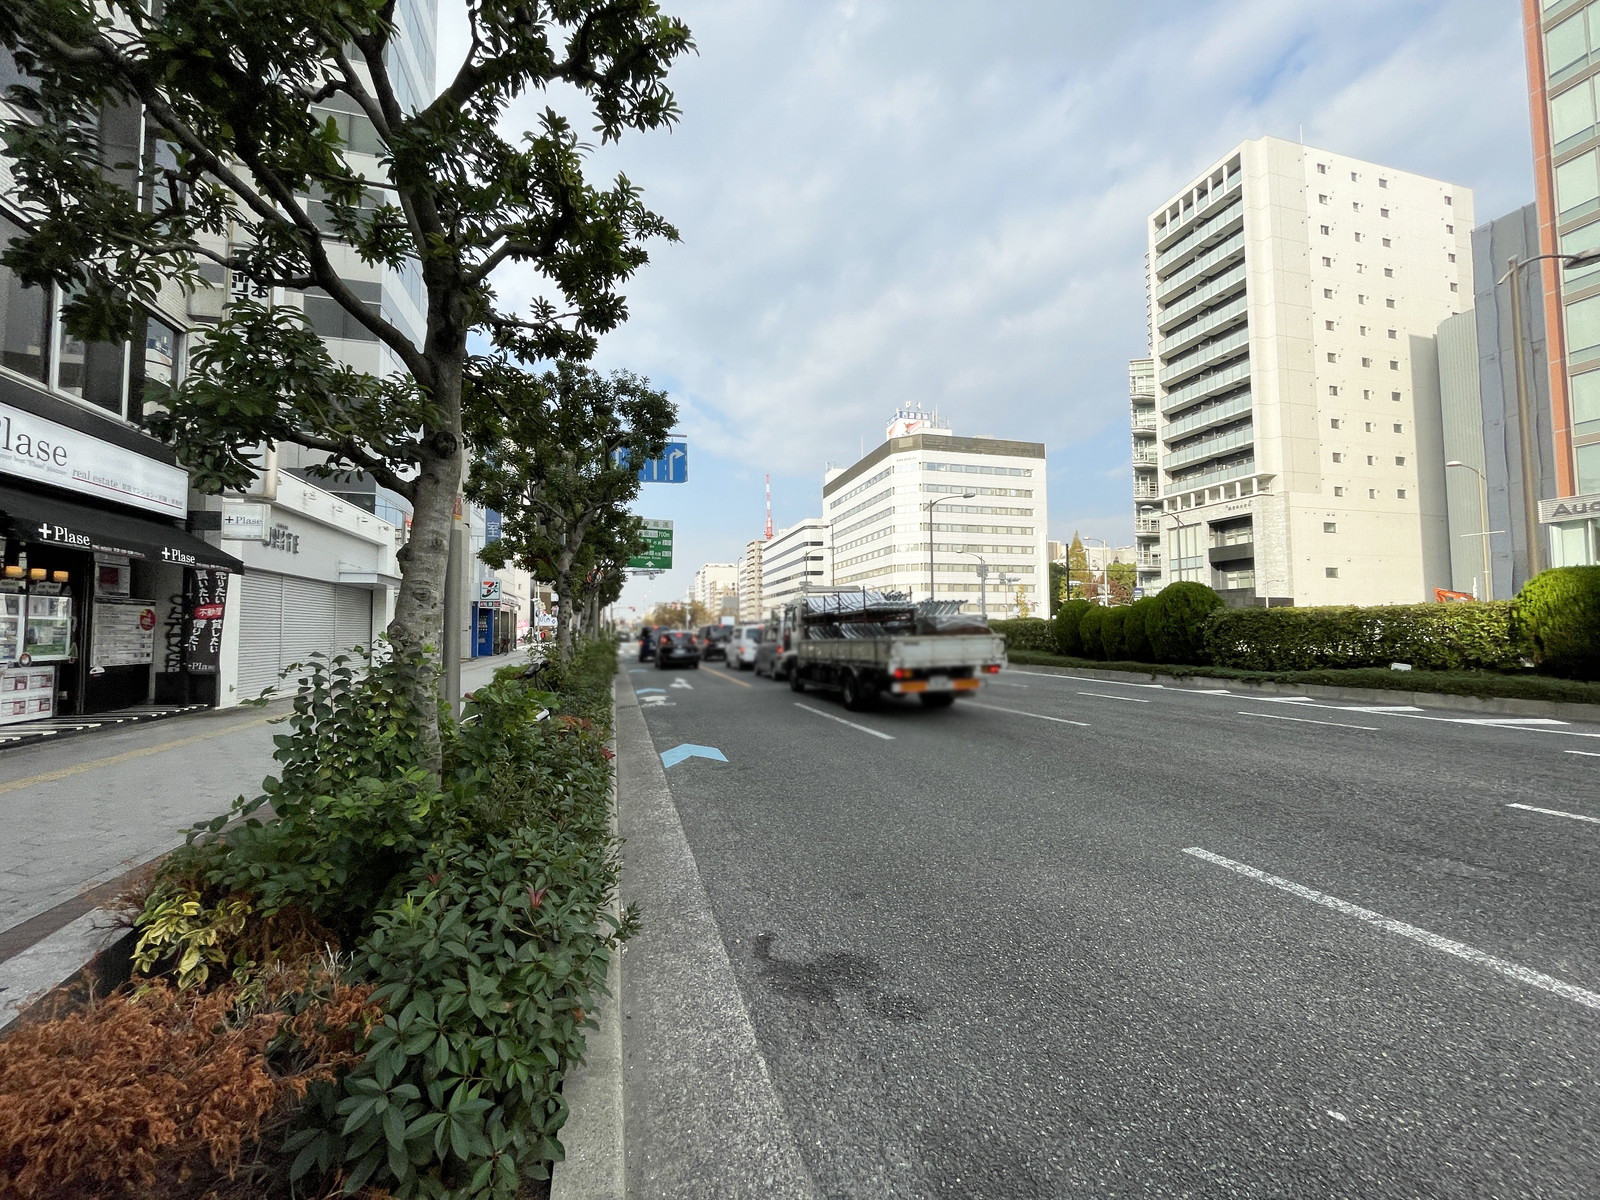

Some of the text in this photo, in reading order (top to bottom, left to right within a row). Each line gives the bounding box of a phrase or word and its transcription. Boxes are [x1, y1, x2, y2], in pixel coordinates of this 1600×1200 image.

[0, 416, 68, 467] lase
[72, 469, 119, 489] real estate
[209, 619, 222, 653] 貸したい
